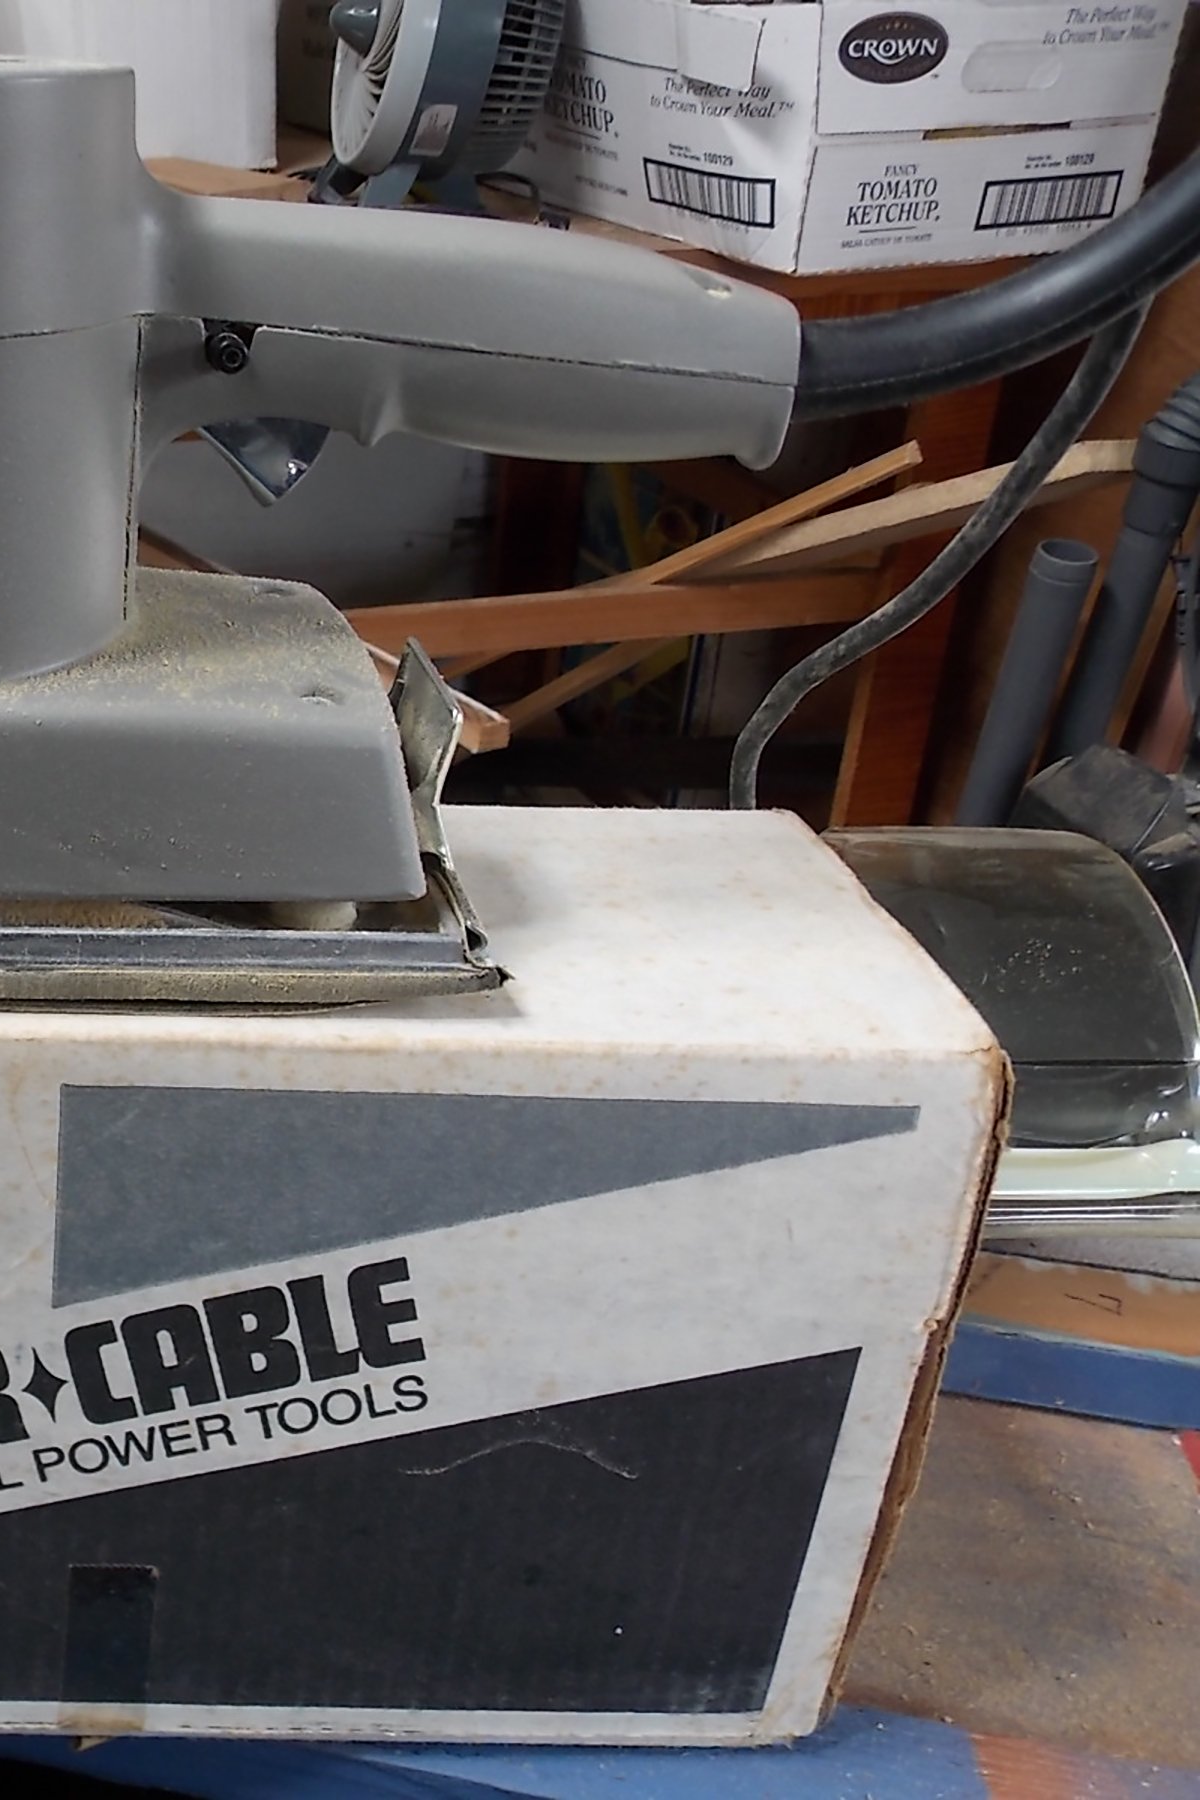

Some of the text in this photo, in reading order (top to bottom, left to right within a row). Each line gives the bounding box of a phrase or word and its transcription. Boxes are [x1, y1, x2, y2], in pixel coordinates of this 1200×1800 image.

[848, 38, 938, 65] CROWN
[664, 77, 684, 94] The
[699, 101, 731, 118] Your
[884, 164, 918, 177] FANCY
[857, 177, 938, 202] TOMATO
[64, 1256, 427, 1426] CABLE
[33, 1413, 237, 1483] POWER
[245, 1374, 429, 1440] TOOLS
